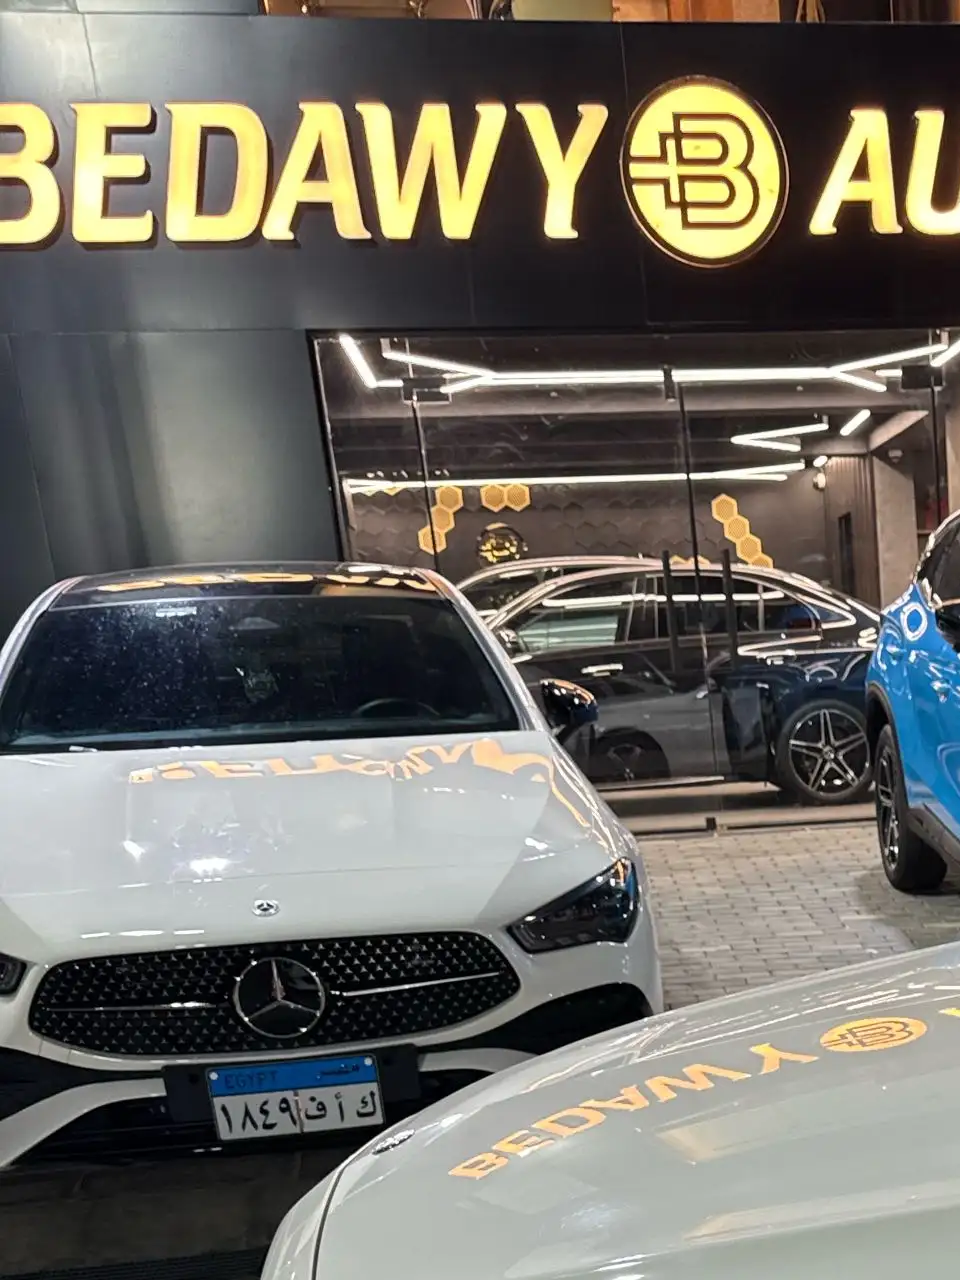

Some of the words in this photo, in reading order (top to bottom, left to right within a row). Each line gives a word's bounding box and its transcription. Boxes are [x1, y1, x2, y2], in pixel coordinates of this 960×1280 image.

[0, 102, 609, 245] BEDAWY
[224, 1069, 278, 1090] EGYPT
[220, 1096, 299, 1134] ١٨٤٩
